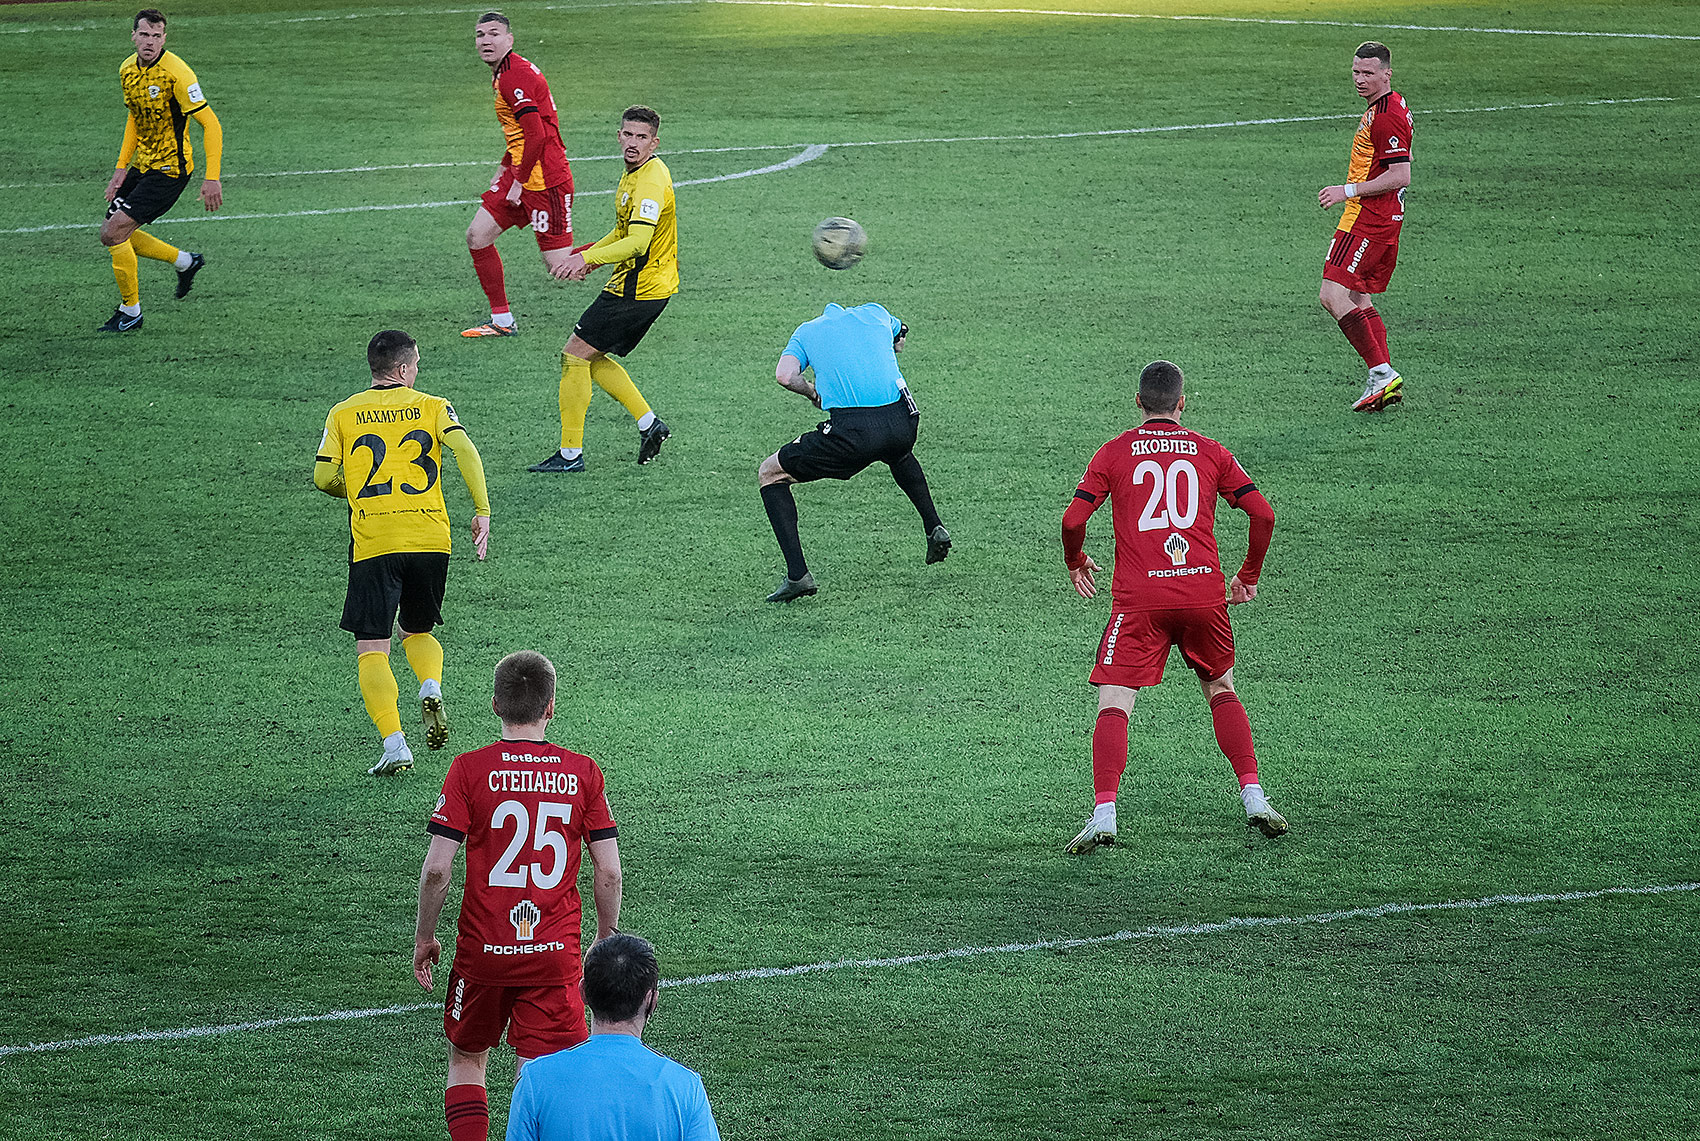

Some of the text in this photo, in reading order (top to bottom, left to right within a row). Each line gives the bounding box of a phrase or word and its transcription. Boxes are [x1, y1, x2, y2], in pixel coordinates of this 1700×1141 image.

[356, 407, 421, 425] МАХМУТОВ
[1138, 428, 1189, 437] BetBoom
[1131, 438, 1198, 456] ЯКОВЛЕВ
[350, 429, 438, 500] 23
[1132, 459, 1199, 532] 20
[1148, 566, 1212, 578] РОСНЕФТЬ
[501, 752, 561, 764] BetBoom
[488, 770, 579, 796] СТЕПАНОВ
[488, 800, 573, 890] 25
[483, 941, 565, 955] РОСНЕФТЬ
[451, 977, 465, 1022] BetBo
